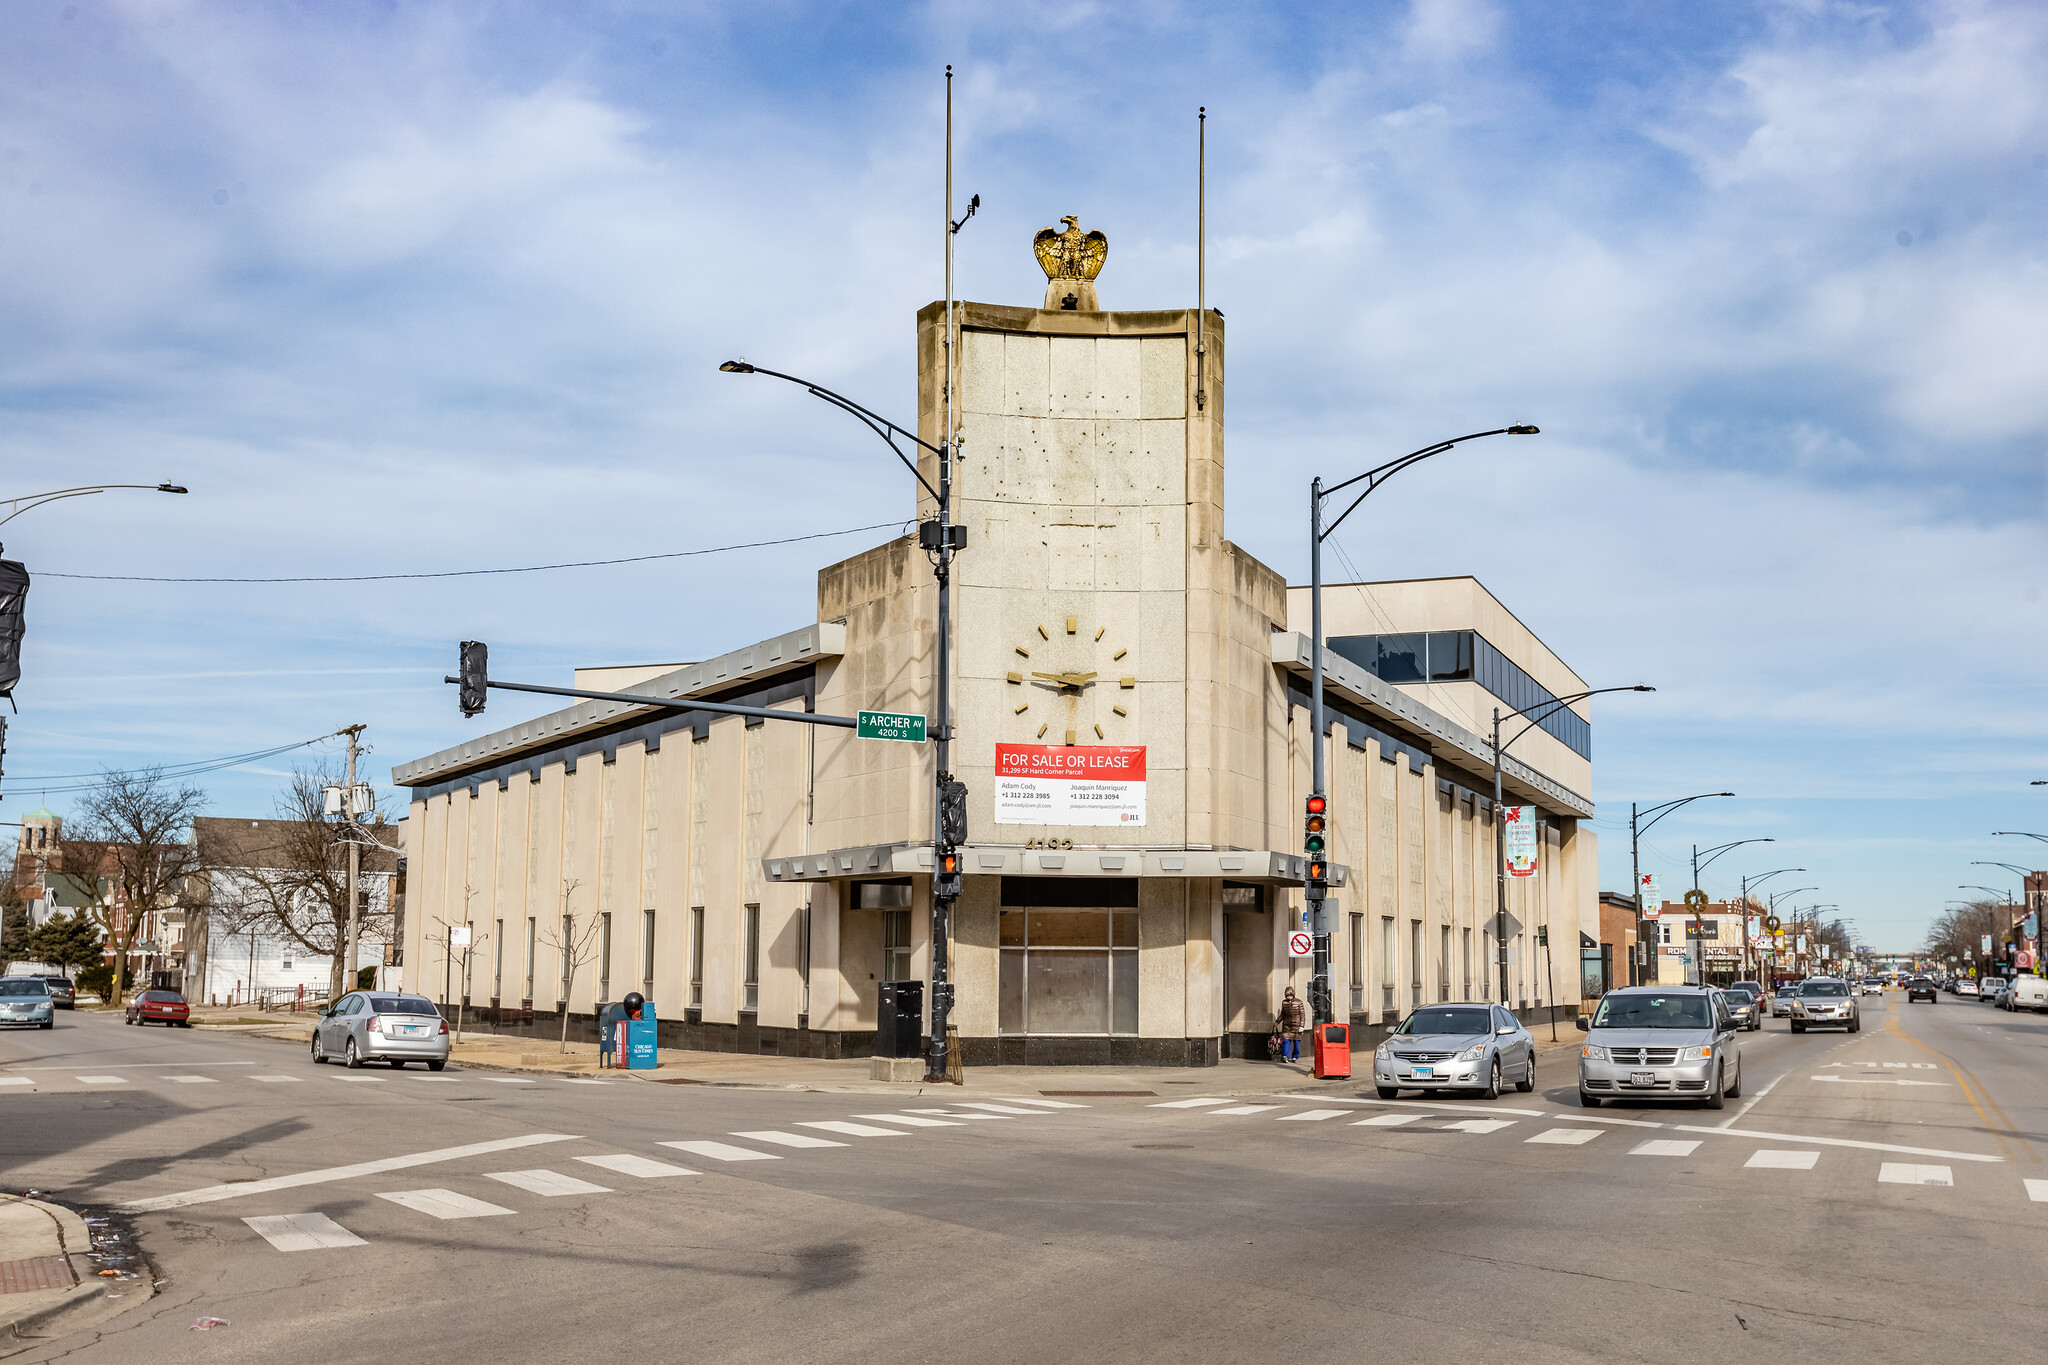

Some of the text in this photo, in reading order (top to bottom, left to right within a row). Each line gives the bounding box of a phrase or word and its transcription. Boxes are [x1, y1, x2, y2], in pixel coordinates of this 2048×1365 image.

[870, 715, 910, 728] ARCHER
[878, 729, 898, 737] 4200
[1002, 754, 1129, 768] FOR SALE OR LEASE
[1025, 837, 1073, 850] 4192
